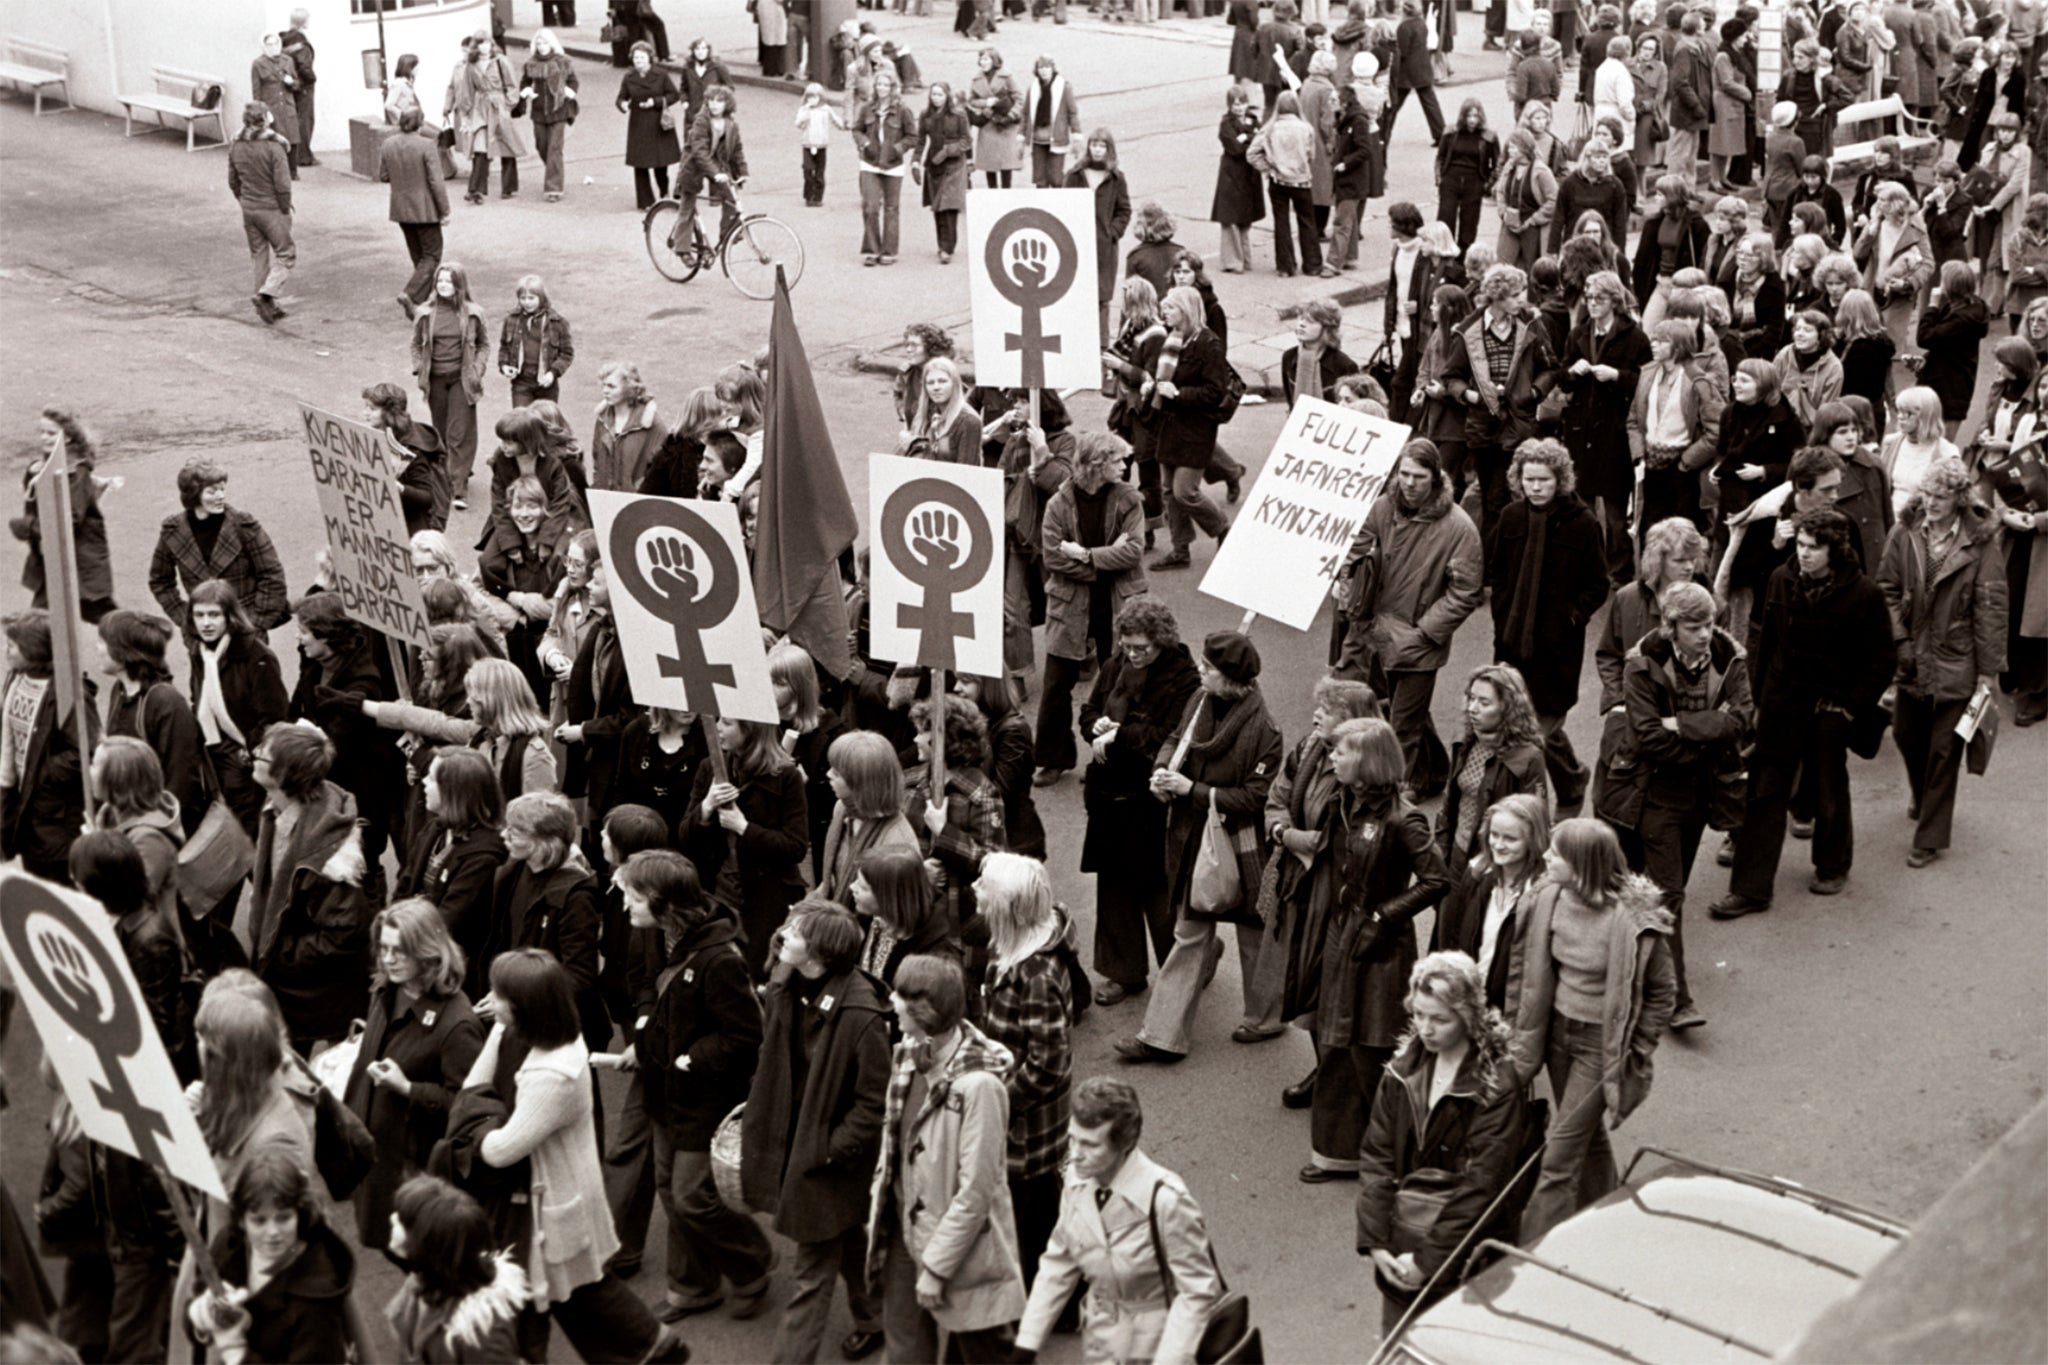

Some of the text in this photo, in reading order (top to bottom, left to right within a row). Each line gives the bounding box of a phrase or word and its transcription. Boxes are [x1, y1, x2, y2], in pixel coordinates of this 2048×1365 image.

[303, 411, 388, 475] KVENNA
[1299, 412, 1381, 455] FULLT
[344, 494, 376, 534] ER
[358, 558, 403, 601] INDA
